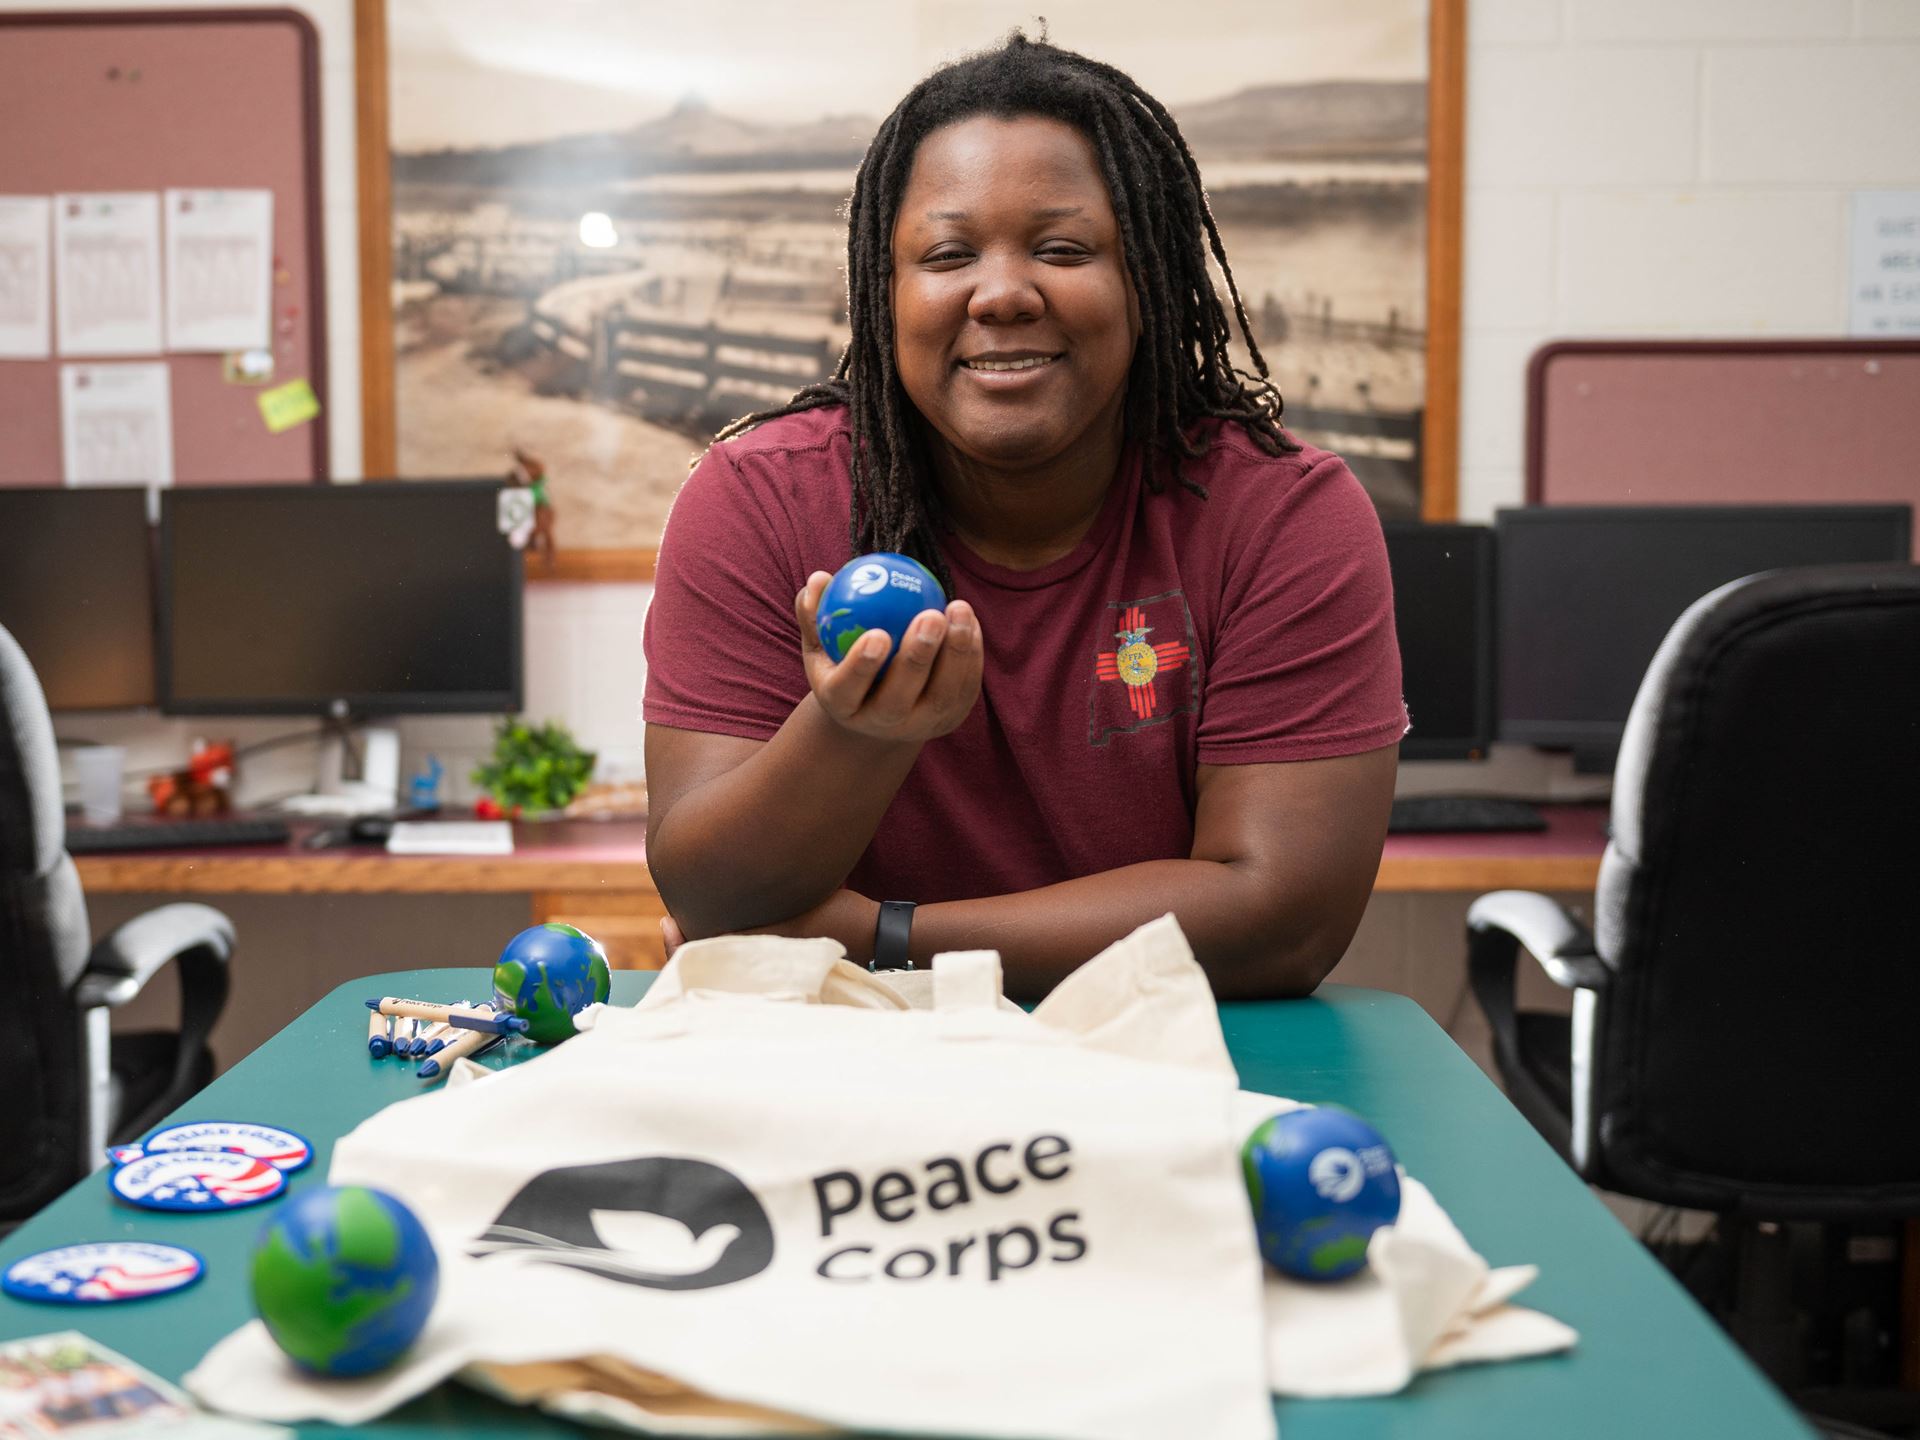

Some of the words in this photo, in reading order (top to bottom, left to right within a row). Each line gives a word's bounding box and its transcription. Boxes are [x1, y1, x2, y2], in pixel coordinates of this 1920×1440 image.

[890, 578, 922, 593] Corps
[891, 570, 922, 585] Peace
[811, 1134, 1072, 1237] Peace
[816, 1212, 1088, 1281] Corps
